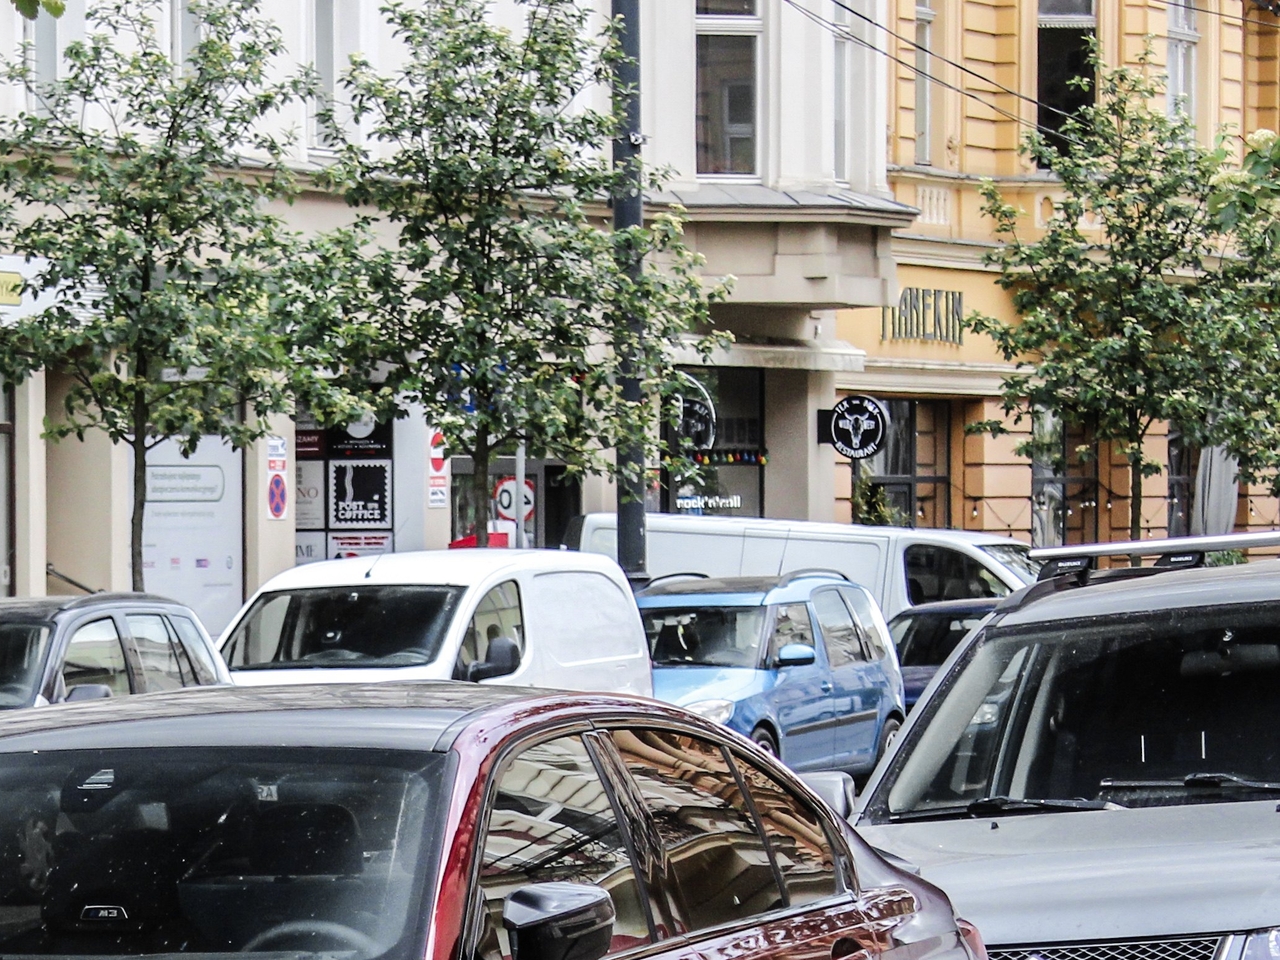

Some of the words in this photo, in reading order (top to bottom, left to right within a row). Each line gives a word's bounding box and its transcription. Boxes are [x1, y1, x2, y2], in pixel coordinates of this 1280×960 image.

[835, 441, 878, 458] RESTAURANT
[338, 501, 365, 511] POST
[676, 495, 741, 509] rock'n'roll
